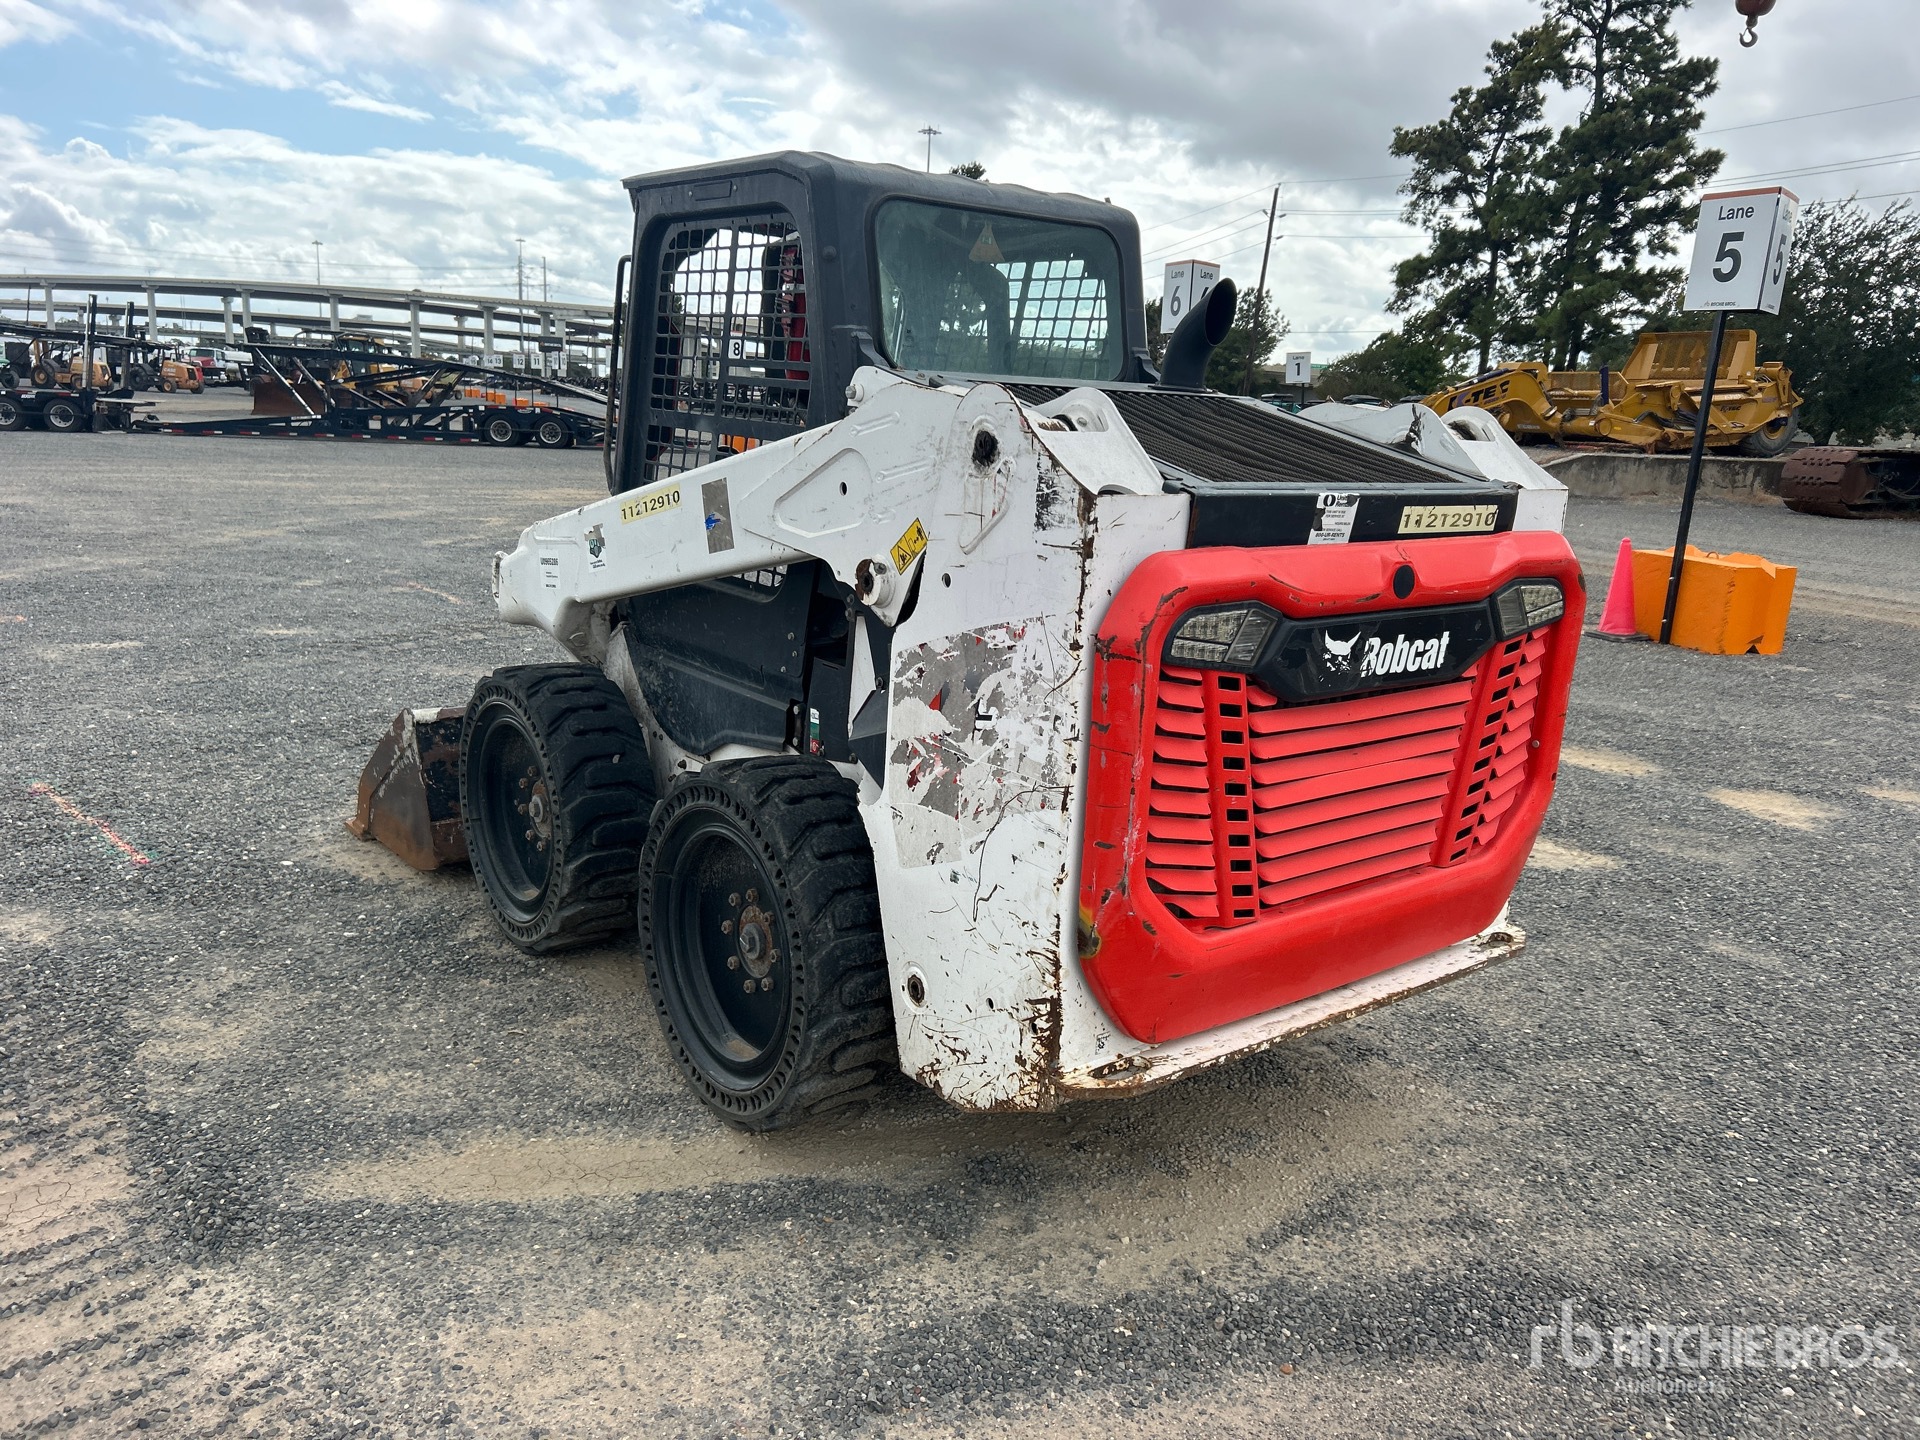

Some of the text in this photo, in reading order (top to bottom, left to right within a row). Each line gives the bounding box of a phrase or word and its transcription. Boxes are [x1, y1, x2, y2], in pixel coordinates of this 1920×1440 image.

[1718, 205, 1755, 221] Lane
[1712, 231, 1745, 283] 5
[1772, 233, 1787, 285] 5
[1171, 269, 1185, 279] Lane
[1200, 269, 1214, 280] Lane
[1170, 285, 1181, 317] 6
[733, 342, 741, 357] 8
[517, 358, 524, 366] 12
[533, 358, 540, 366] 11
[1295, 362, 1301, 376] 1
[621, 490, 681, 520] 11212910
[1403, 511, 1497, 529] 11212910
[1360, 631, 1450, 678] Bobcat
